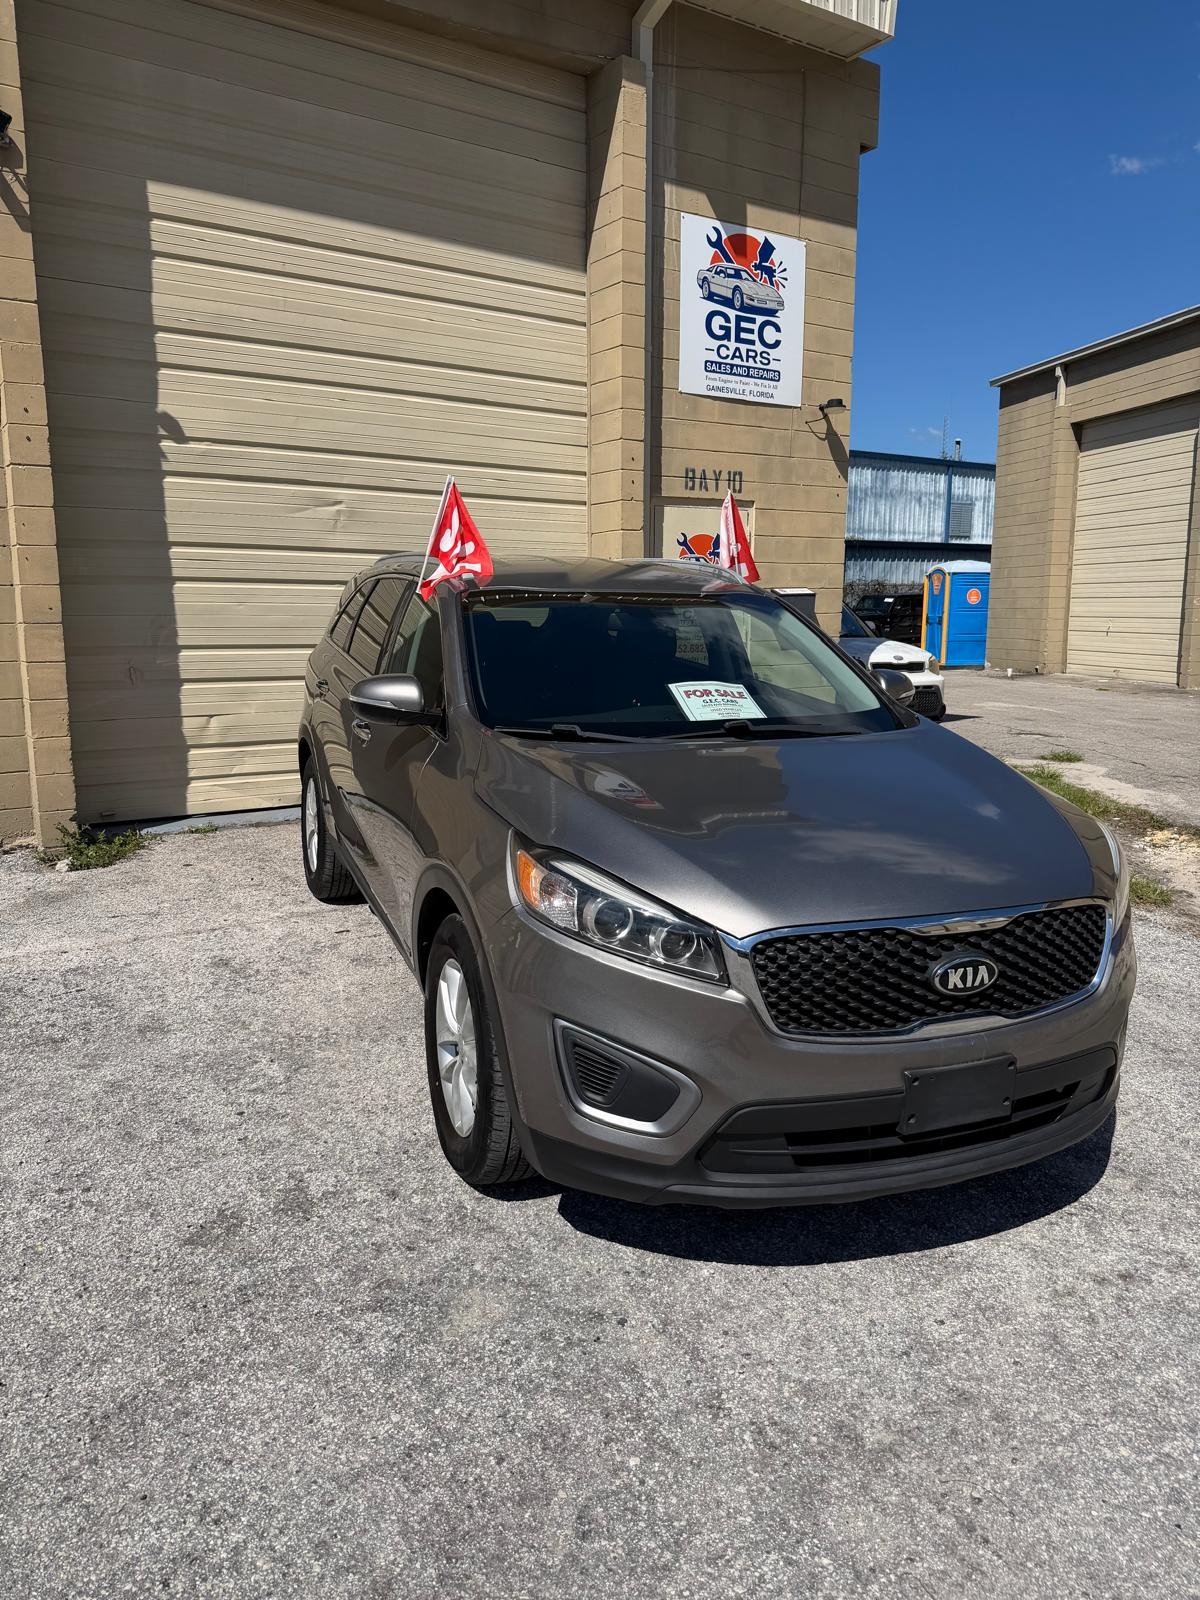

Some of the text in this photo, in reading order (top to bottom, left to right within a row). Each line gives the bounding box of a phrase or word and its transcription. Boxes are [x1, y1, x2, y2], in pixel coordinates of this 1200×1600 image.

[705, 310, 782, 349] GEC
[716, 344, 771, 366] CARS
[706, 362, 779, 380] SALES AND REPAIRS
[706, 384, 774, 399] GAINESVILLE, FLORIDA
[685, 467, 743, 494] BAY 10
[683, 689, 748, 699] FOR SALE
[947, 965, 989, 989] KIA
